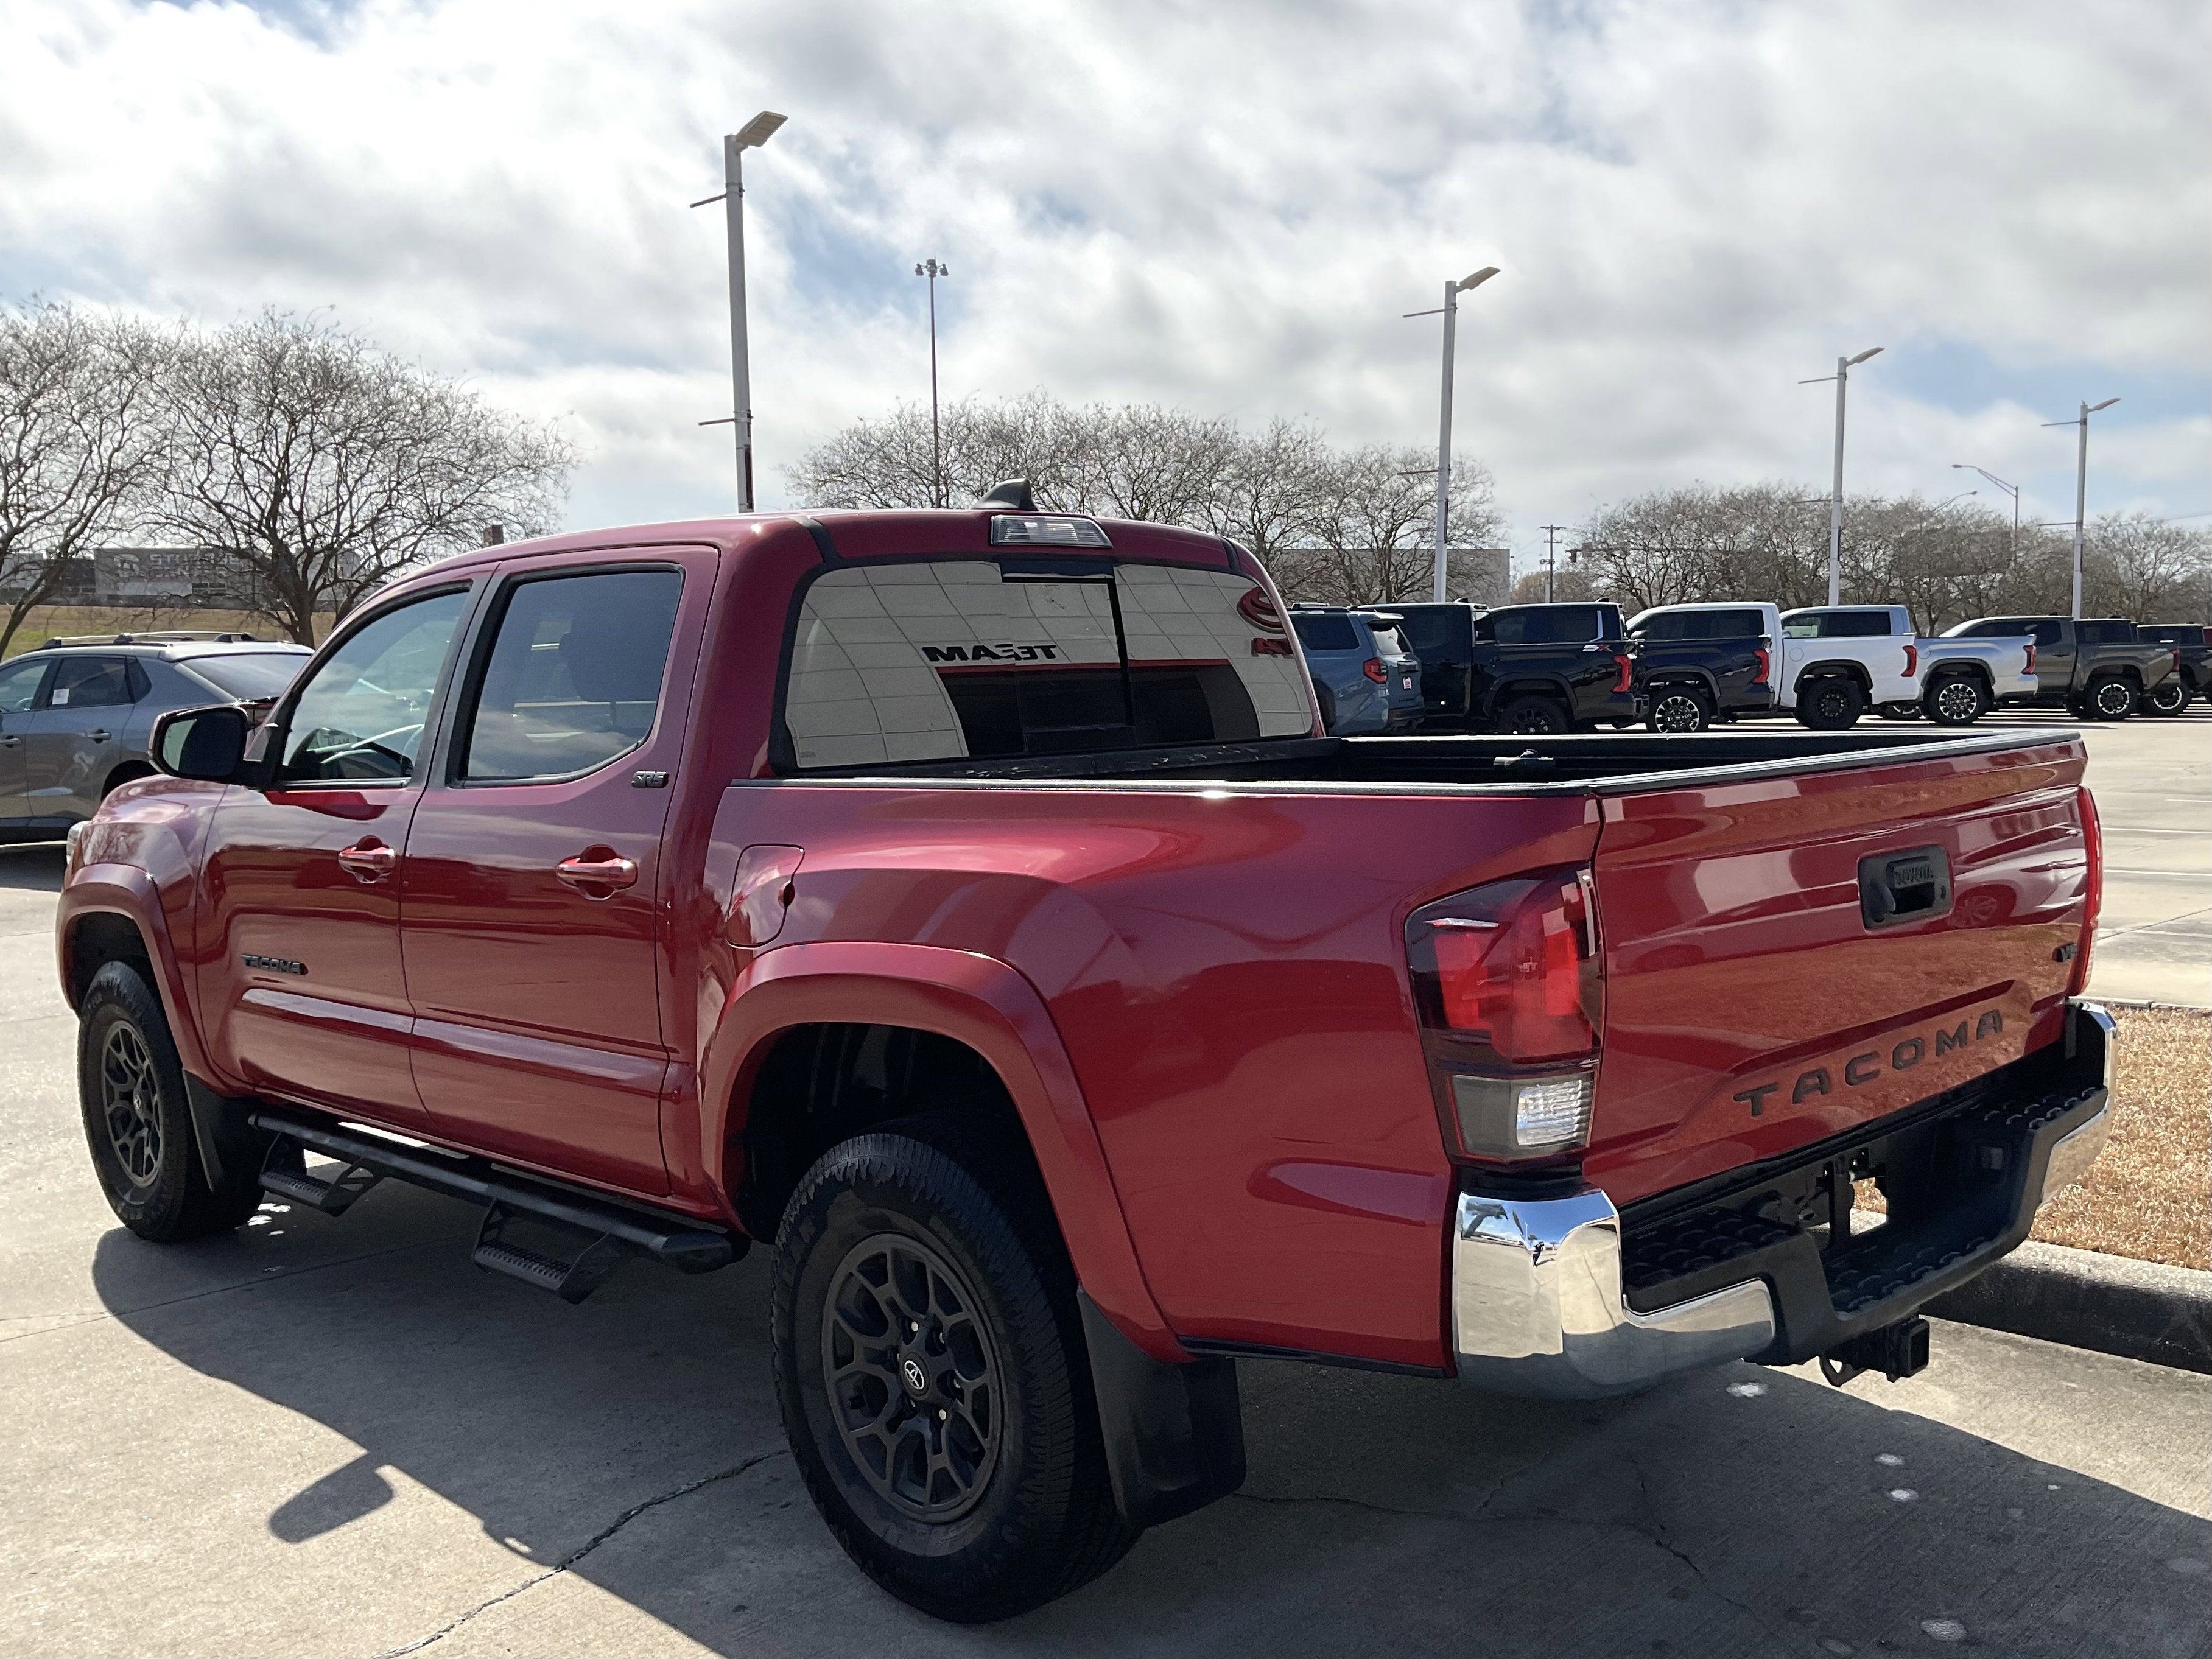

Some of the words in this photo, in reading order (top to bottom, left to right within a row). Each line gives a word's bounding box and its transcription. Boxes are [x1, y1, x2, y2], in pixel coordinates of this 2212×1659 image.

[631, 770, 668, 788] SR5
[241, 954, 304, 975] TACOMA
[1733, 1009, 2003, 1117] TACOMA
